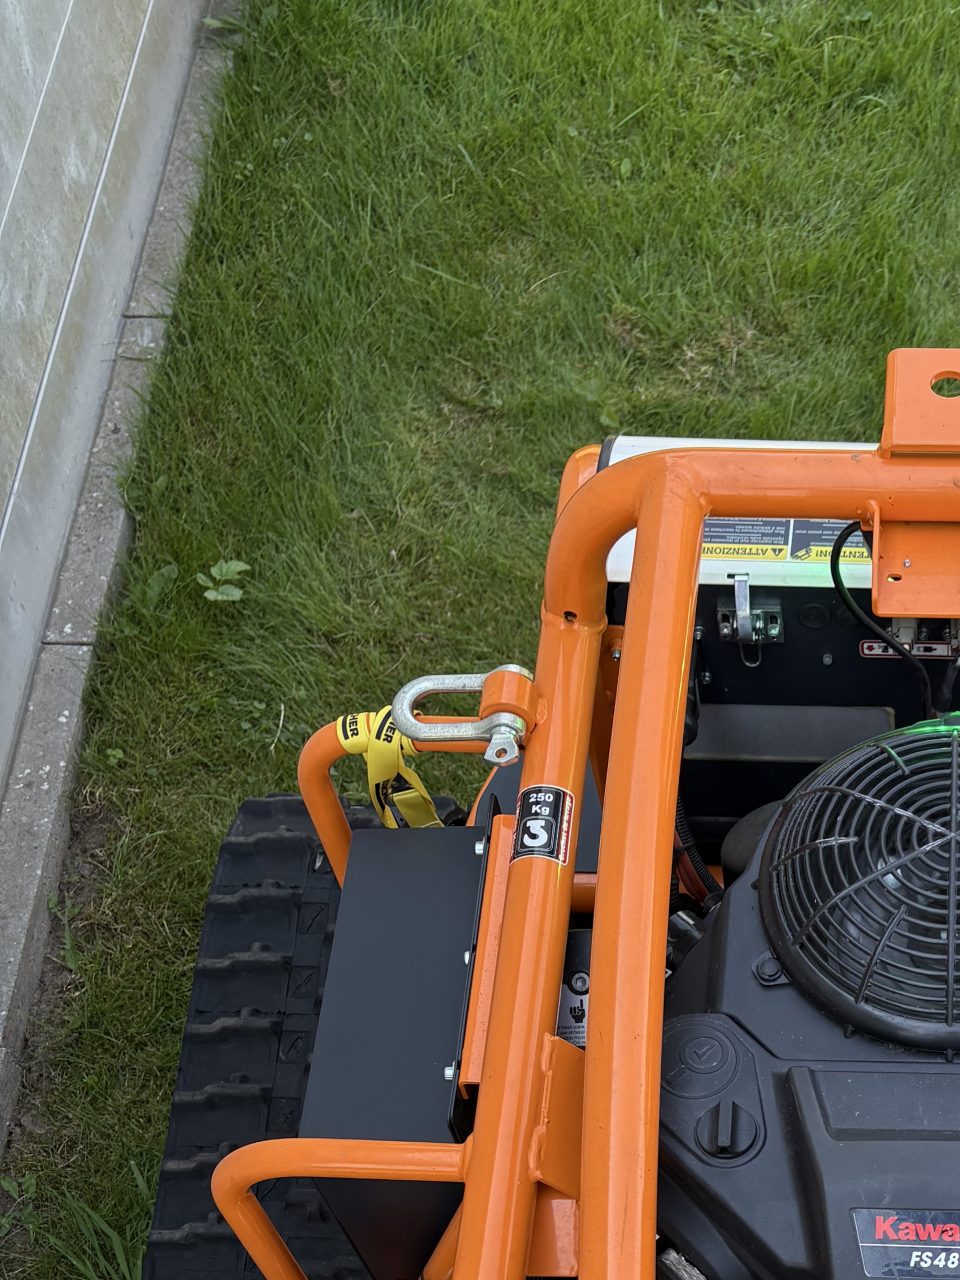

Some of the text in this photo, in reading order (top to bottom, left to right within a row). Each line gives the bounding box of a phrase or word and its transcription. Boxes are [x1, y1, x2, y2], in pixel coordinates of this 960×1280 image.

[348, 713, 359, 738] HER
[528, 792, 554, 803] 250
[531, 804, 550, 816] Kg
